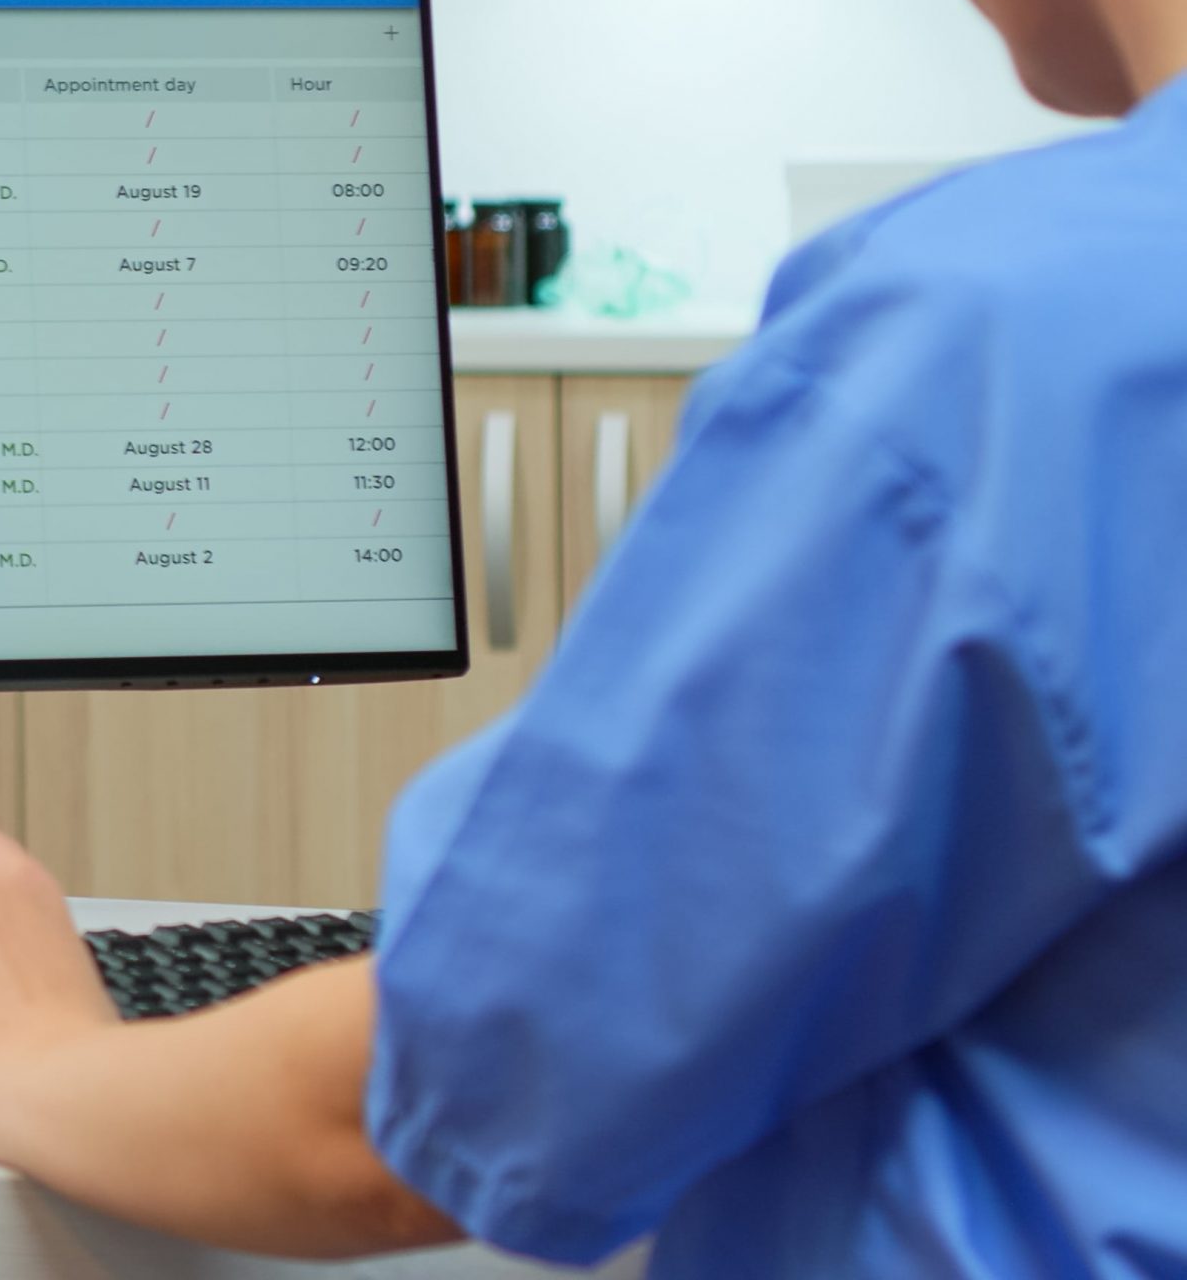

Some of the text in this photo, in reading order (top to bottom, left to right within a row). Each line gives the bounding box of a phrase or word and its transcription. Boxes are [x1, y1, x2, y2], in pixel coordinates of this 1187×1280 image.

[43, 77, 197, 95] Appointment day
[290, 78, 332, 91] Hour
[116, 185, 202, 202] August 19
[331, 184, 384, 197] 08:00
[118, 257, 196, 274] August 7
[336, 257, 388, 271] 09:20
[1, 442, 39, 456] M.D.
[123, 440, 213, 457] August 28
[347, 437, 396, 451] 12:00
[2, 479, 39, 494] M.D.
[129, 477, 211, 494] August 11
[353, 475, 395, 489] 11:30
[0, 553, 36, 567] M.D.
[135, 550, 213, 568] August 2
[354, 548, 403, 563] 14:00
